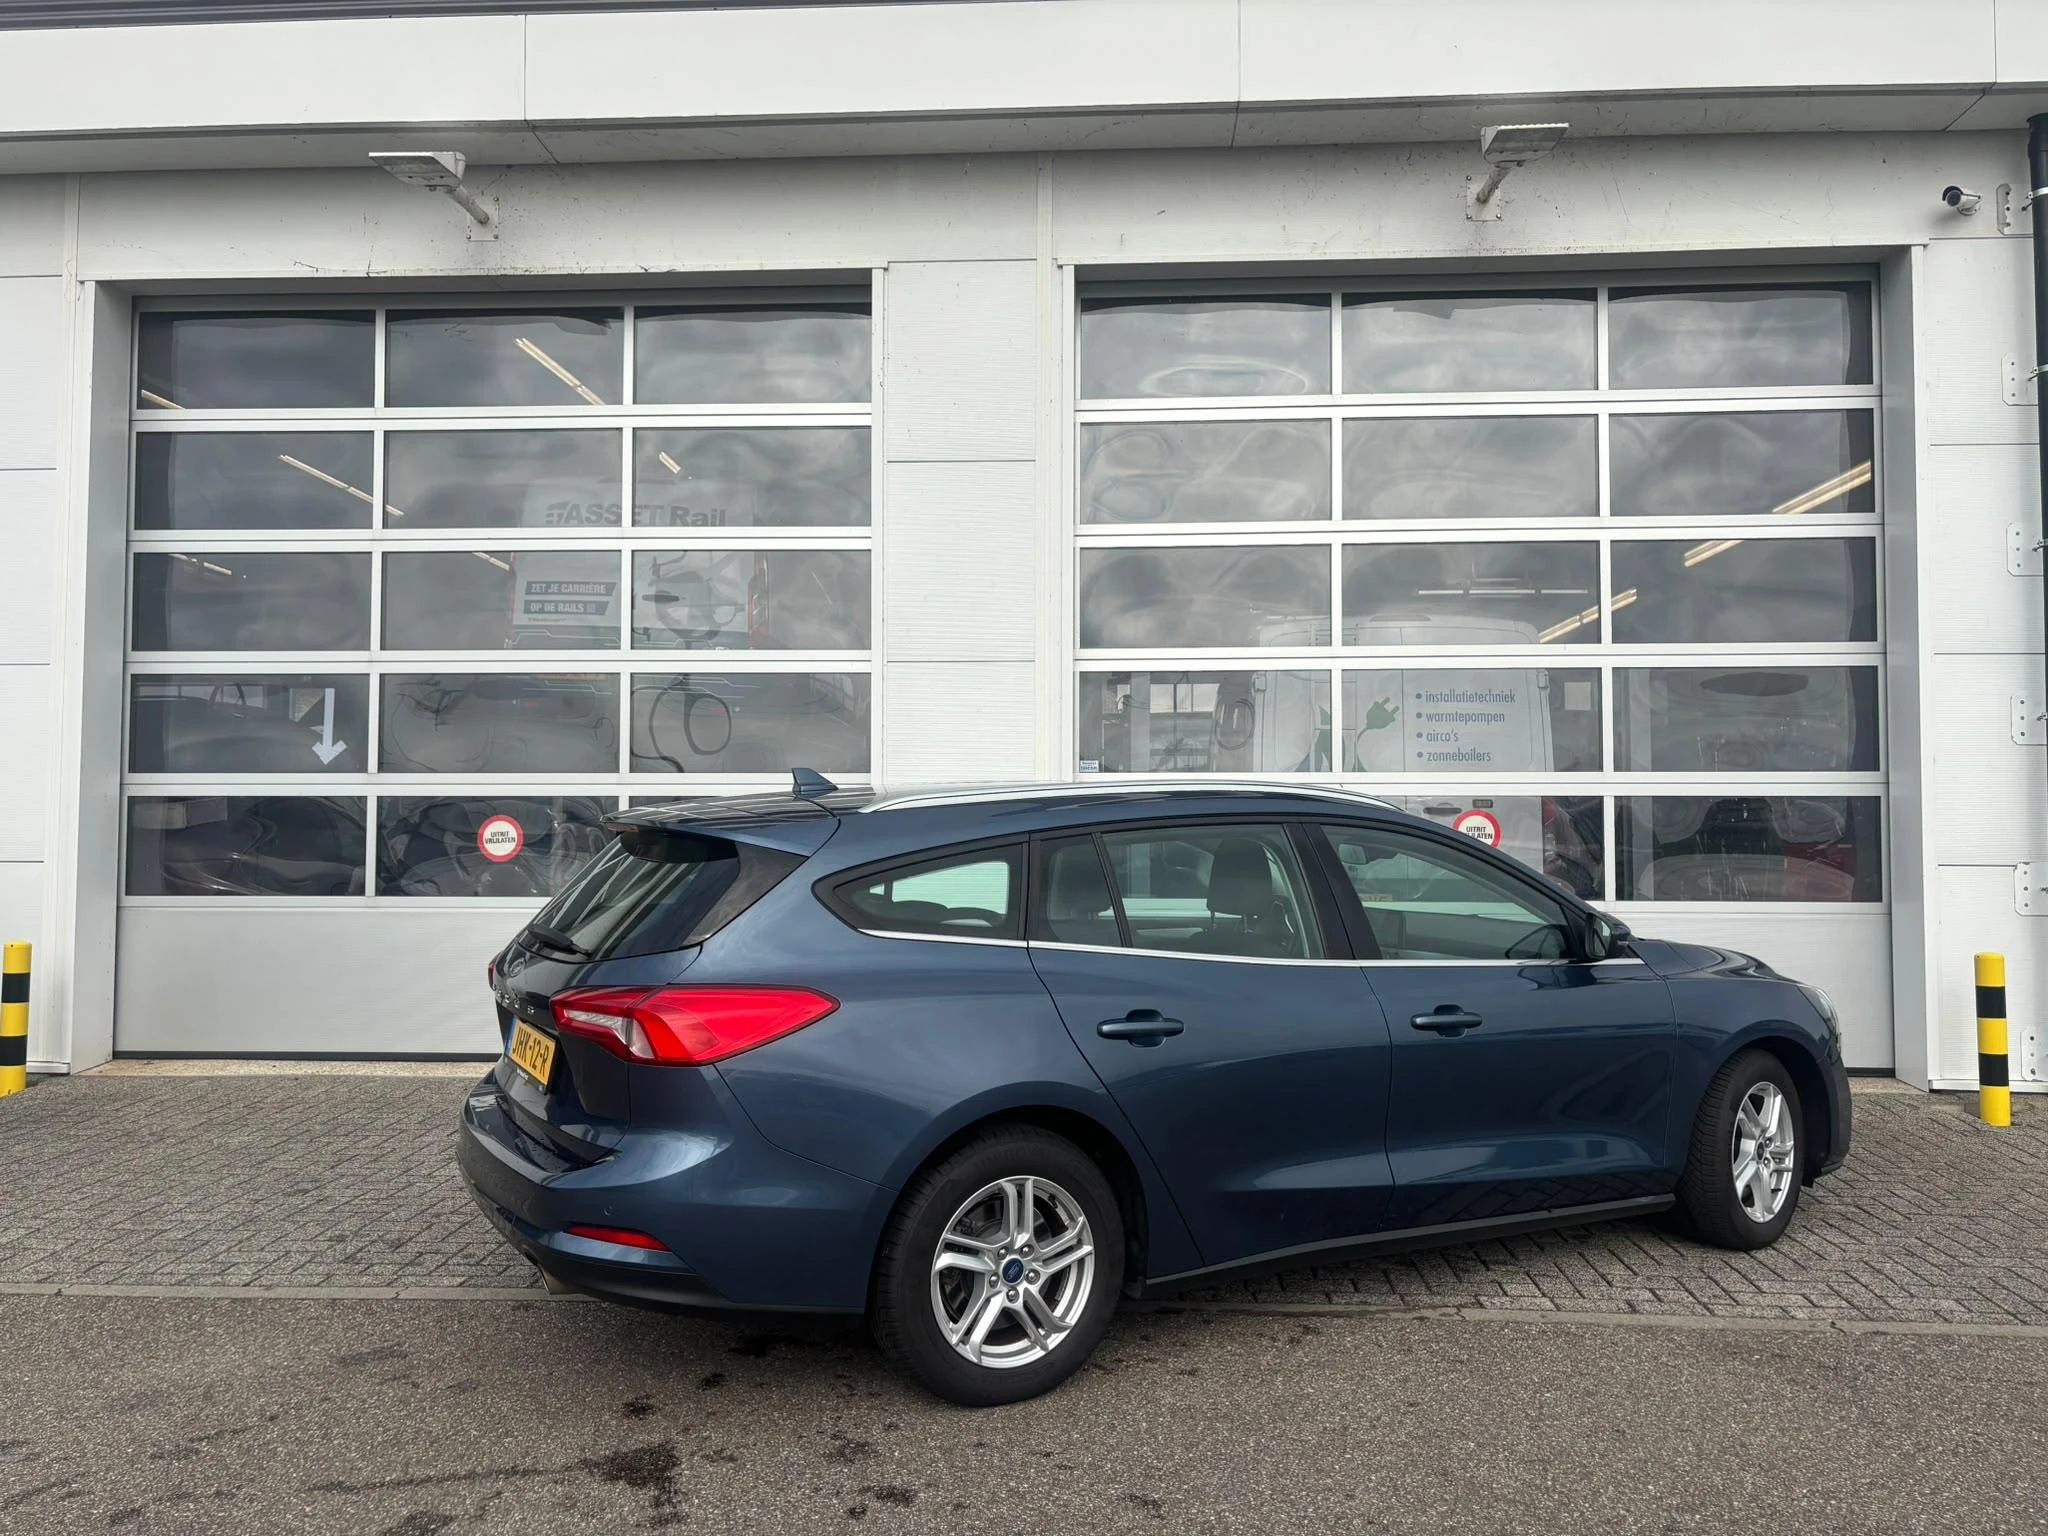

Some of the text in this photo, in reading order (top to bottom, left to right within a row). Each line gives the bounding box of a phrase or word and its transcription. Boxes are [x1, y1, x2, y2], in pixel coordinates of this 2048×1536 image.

[669, 505, 727, 527] Rail
[531, 582, 607, 594] ZET JE CARRIÈRE
[530, 602, 585, 613] OP DE RAILS
[1425, 688, 1516, 703] installatietechniek
[1426, 711, 1505, 725] warmtepompen
[1426, 728, 1459, 742] airco's
[1427, 748, 1492, 762] zonneboilers
[512, 1025, 550, 1077] JHK-12-R
